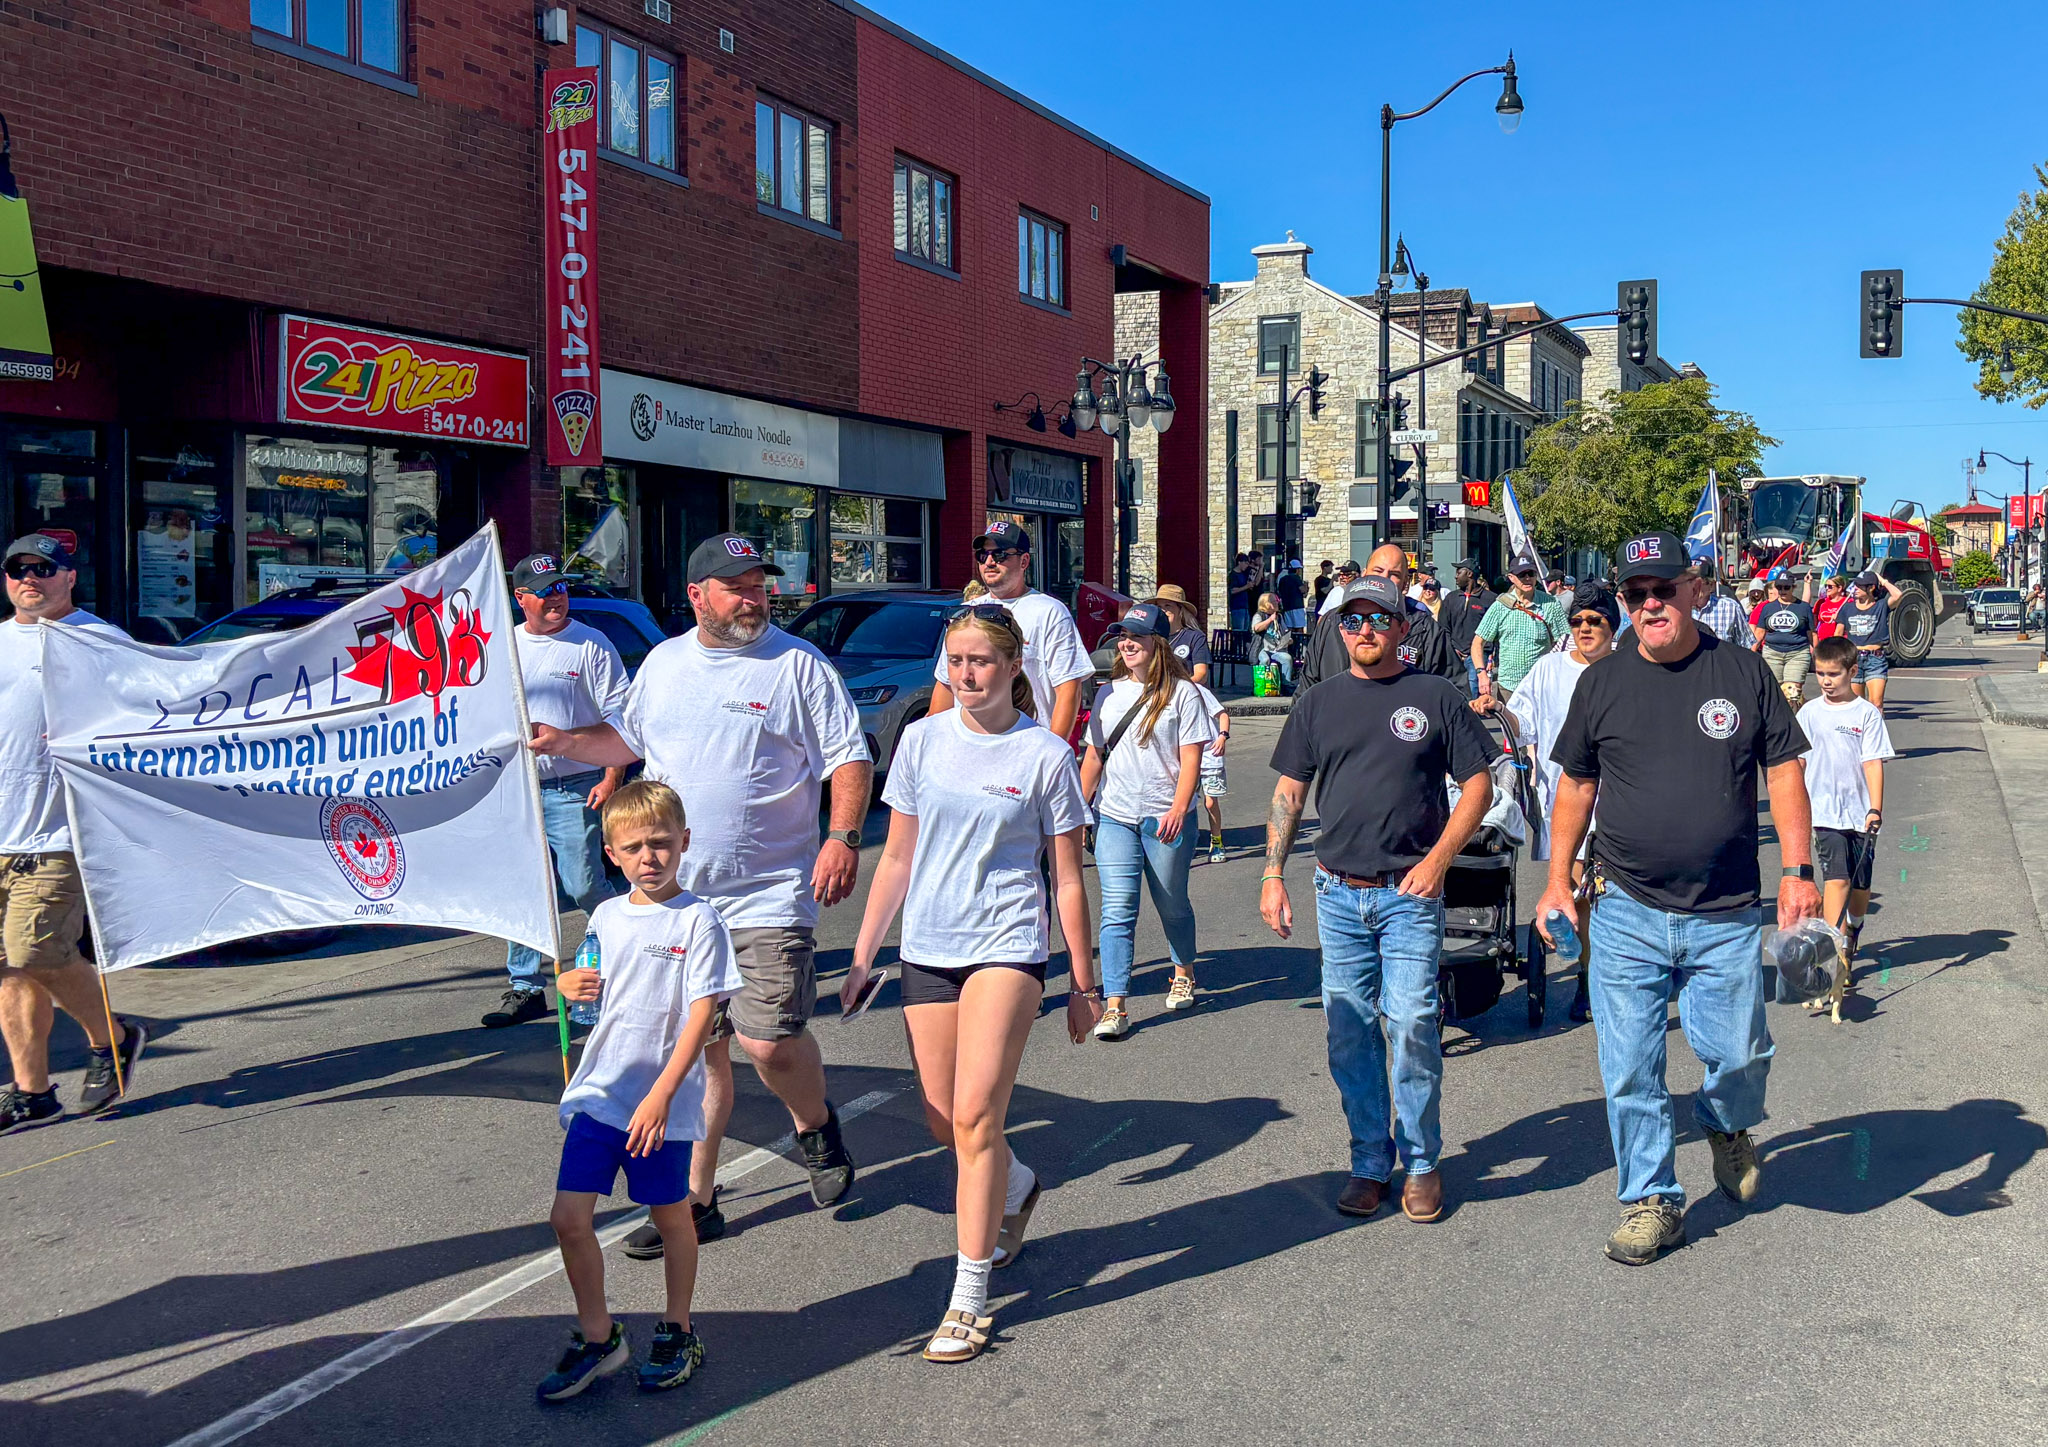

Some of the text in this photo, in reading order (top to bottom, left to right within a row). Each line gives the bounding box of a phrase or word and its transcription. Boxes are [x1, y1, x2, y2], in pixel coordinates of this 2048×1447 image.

[554, 84, 591, 107] 241
[546, 105, 594, 133] Pizza
[558, 148, 591, 378] 547-0-241
[0, 361, 53, 379] 455999
[300, 347, 478, 412] 241 Pizza
[557, 396, 592, 416] PIZZA
[665, 409, 705, 432] Master
[709, 417, 753, 440] Lanzhou
[757, 426, 792, 446] Noodle
[1395, 434, 1424, 442] CLERGY
[1011, 467, 1075, 502] WORKS
[1015, 496, 1077, 510] GOURMET BURGER BISTRO
[1626, 536, 1661, 563] OE
[1772, 617, 1795, 626] 1919
[353, 587, 489, 705] 793
[88, 695, 458, 778] international union of
[352, 796, 396, 837] OPERATING
[344, 857, 367, 880] LABOR
[354, 903, 394, 916] ONTARIO
